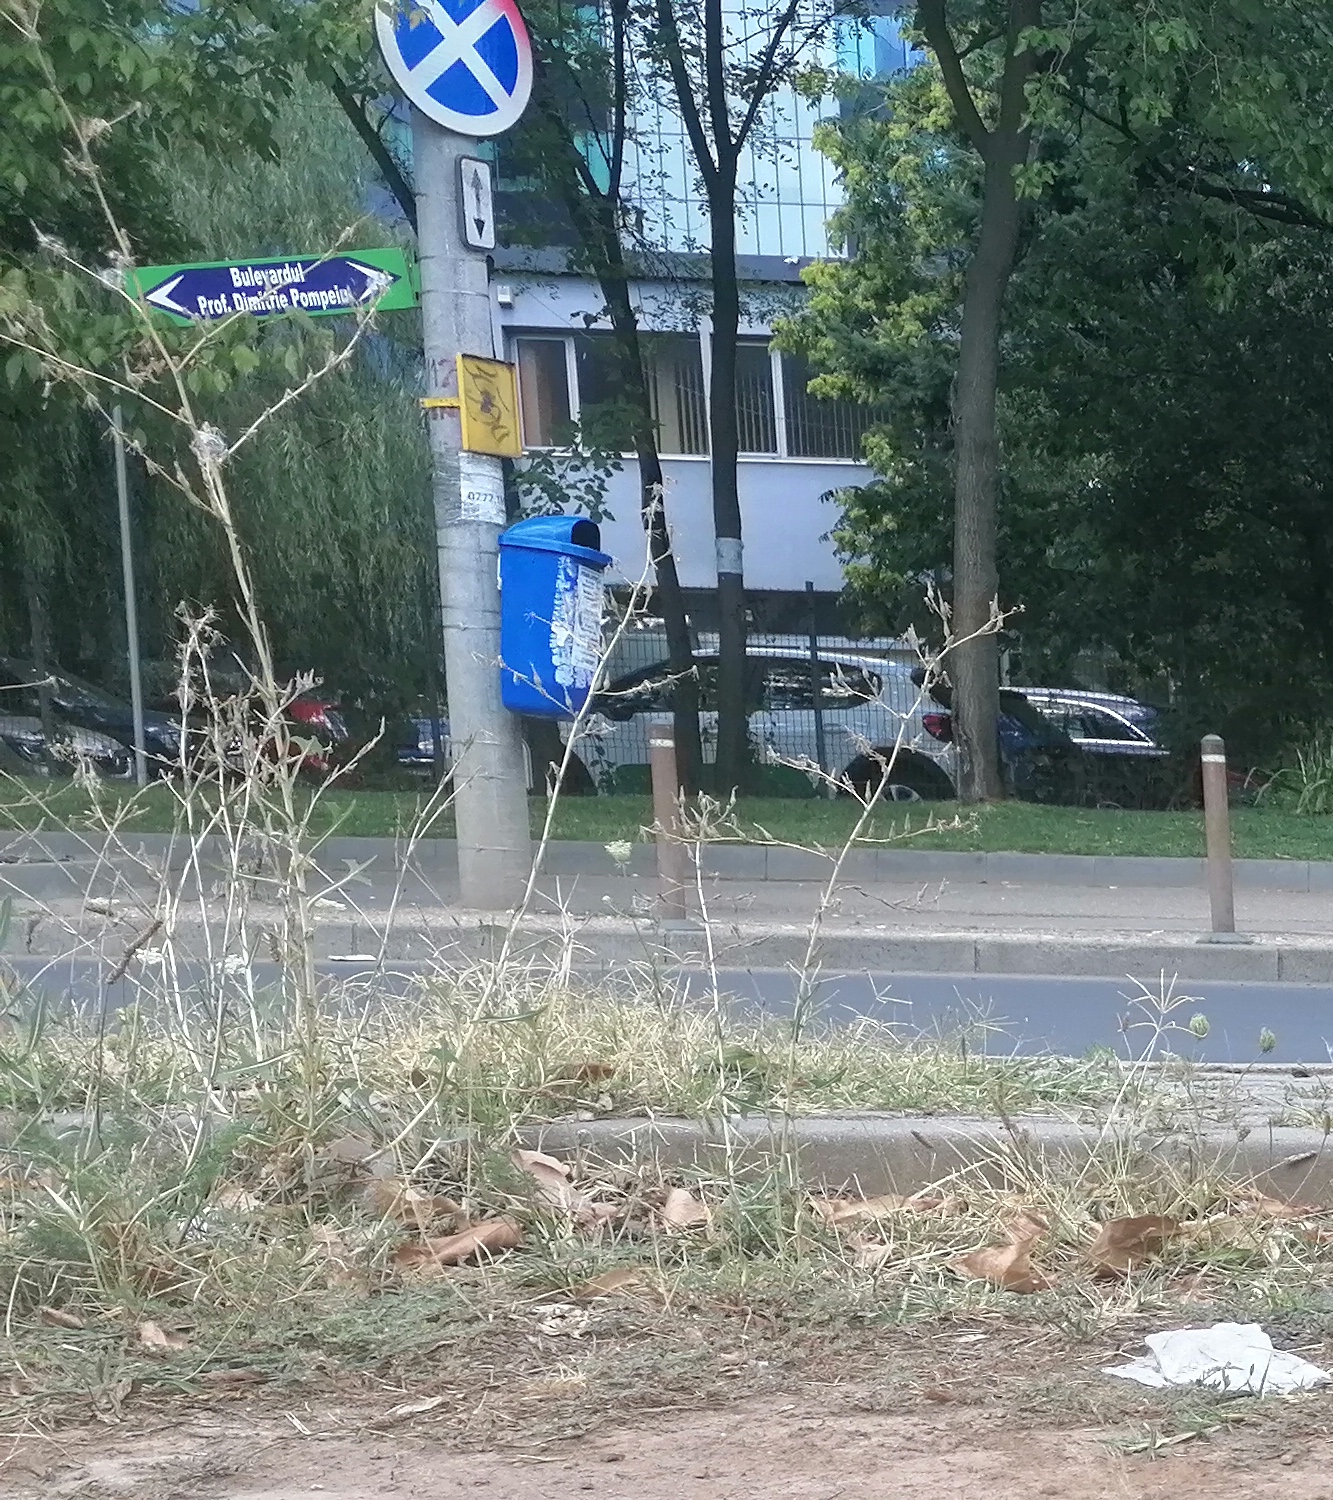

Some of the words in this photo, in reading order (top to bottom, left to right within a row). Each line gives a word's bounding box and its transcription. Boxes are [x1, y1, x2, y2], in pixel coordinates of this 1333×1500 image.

[230, 262, 305, 287] Bulevardul
[197, 292, 232, 315] Prof.
[232, 289, 289, 311] Dimitrie
